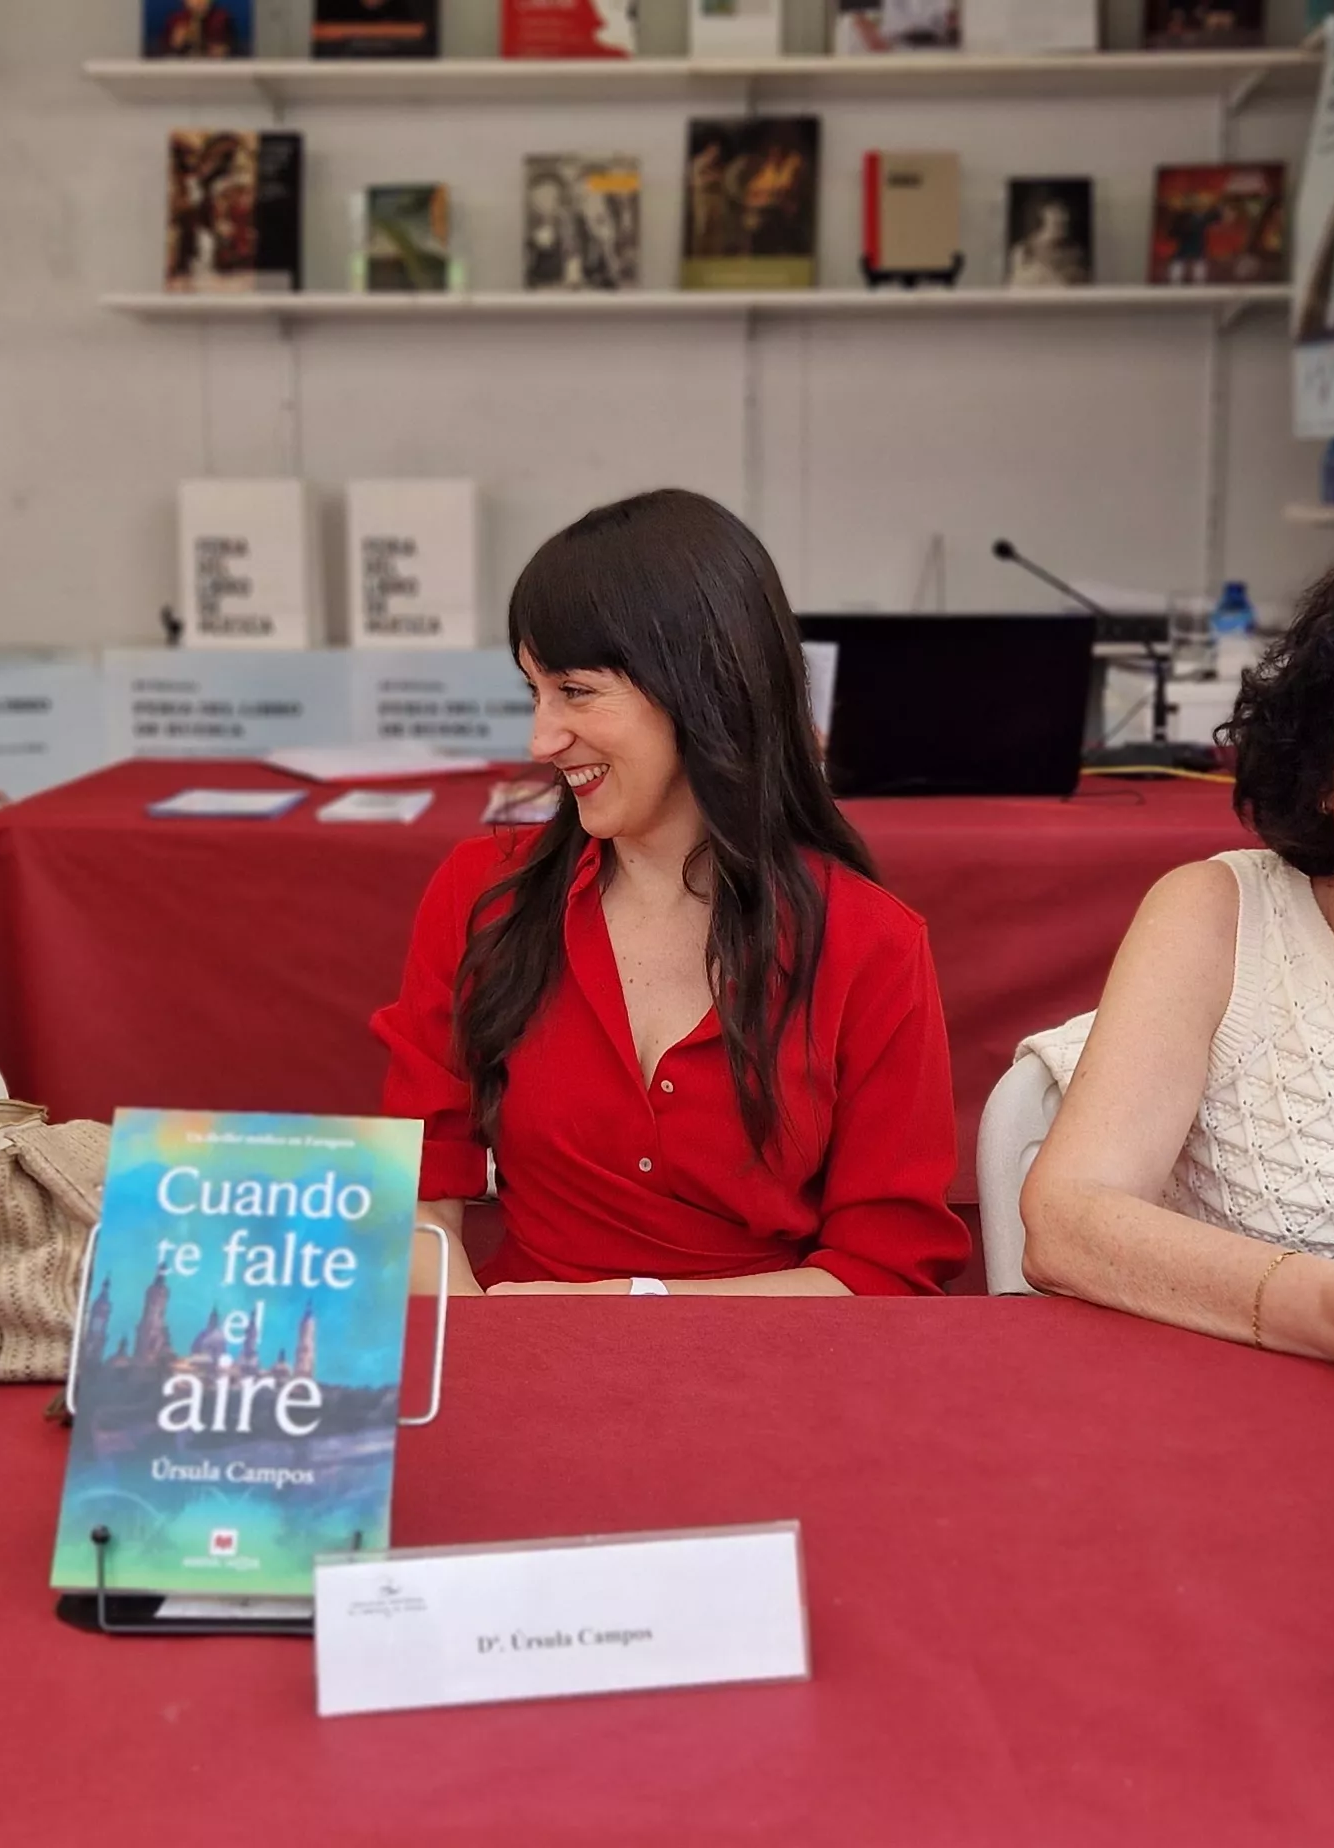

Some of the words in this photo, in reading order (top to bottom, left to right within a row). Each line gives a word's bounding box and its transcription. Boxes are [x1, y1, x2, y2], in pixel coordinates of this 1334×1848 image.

[157, 1165, 371, 1221] Cuando
[157, 1236, 203, 1277] te
[222, 1227, 358, 1290] falte
[223, 1299, 265, 1345] el
[157, 1353, 323, 1436] aire
[151, 1456, 220, 1482] Úrsula
[225, 1460, 315, 1490] Campos
[511, 1628, 572, 1651] Úrsula
[578, 1627, 654, 1648] Campos
